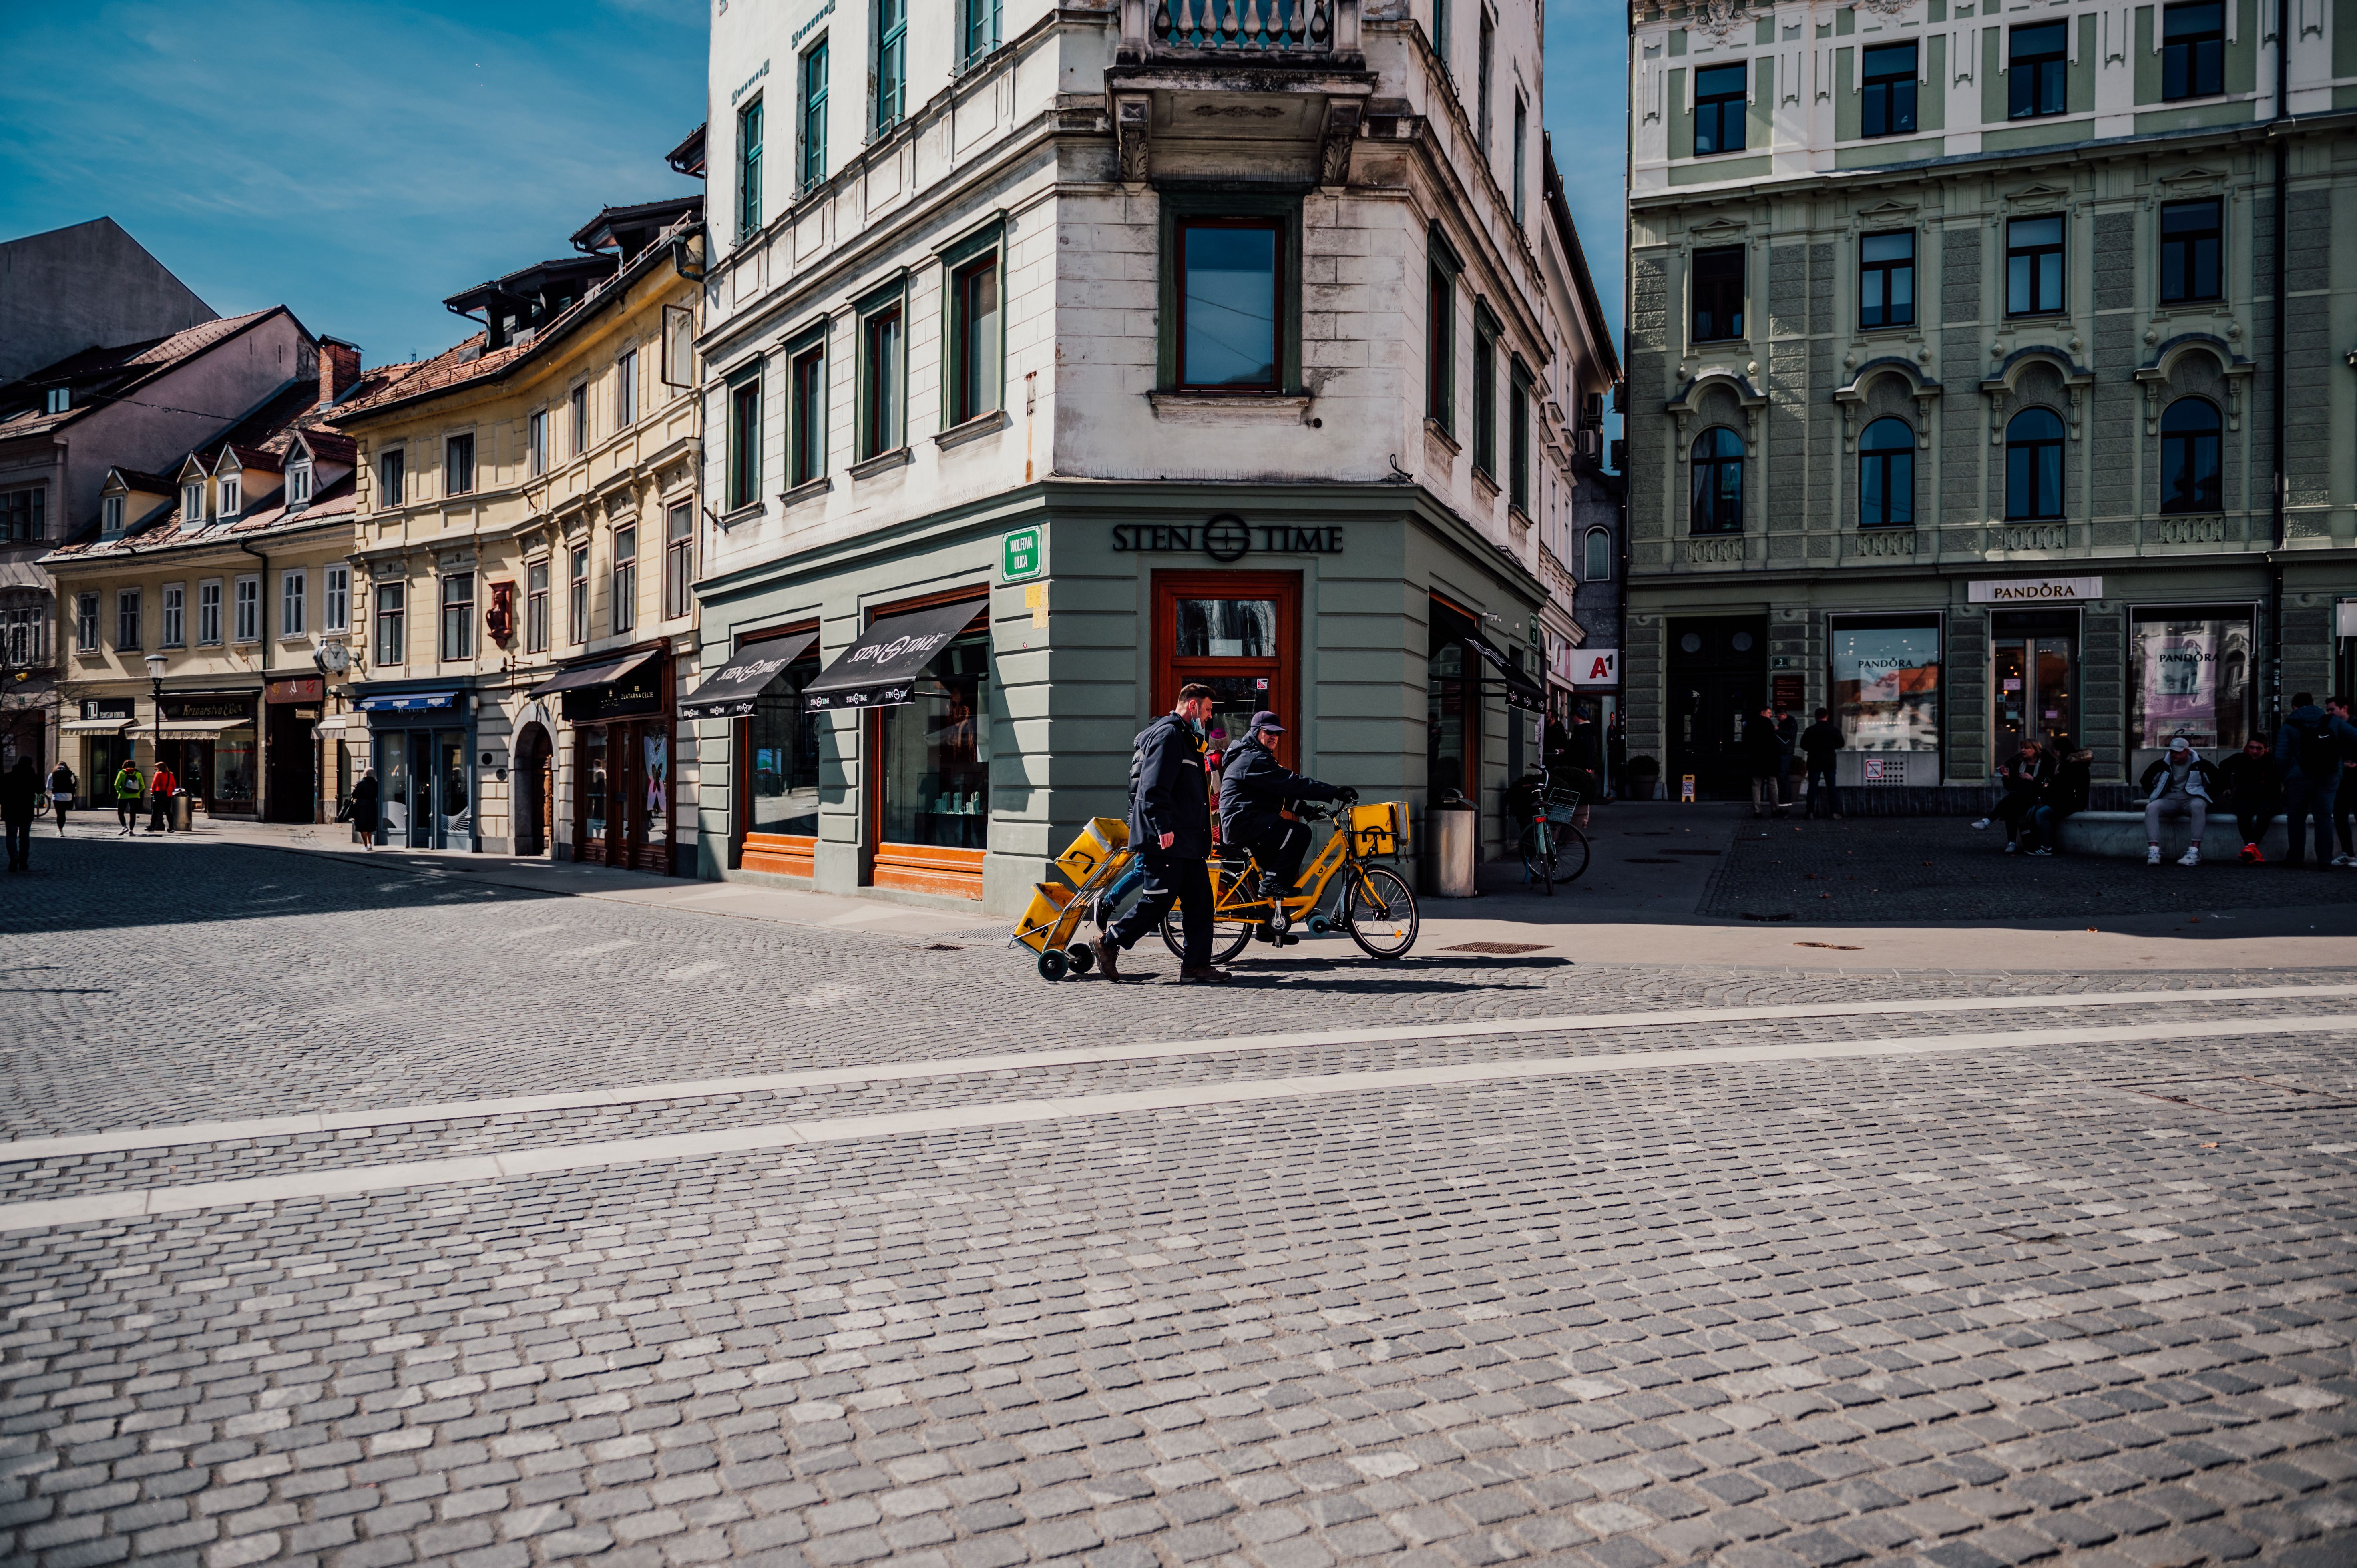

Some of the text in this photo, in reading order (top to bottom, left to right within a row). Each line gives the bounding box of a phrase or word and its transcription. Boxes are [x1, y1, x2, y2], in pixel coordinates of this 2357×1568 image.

[1009, 536, 1033, 553] WOLFOVA
[1113, 524, 1344, 553] STEN TIME
[1014, 554, 1028, 570] ULICA
[1995, 582, 2075, 598] PANDORA
[847, 633, 945, 663] STEN TIME
[1858, 658, 1913, 668] PANDORA
[2160, 652, 2220, 662] PANDORA
[716, 658, 786, 681] STEN TIME
[1589, 654, 1613, 679] A1
[183, 704, 223, 716] Krznarstvo
